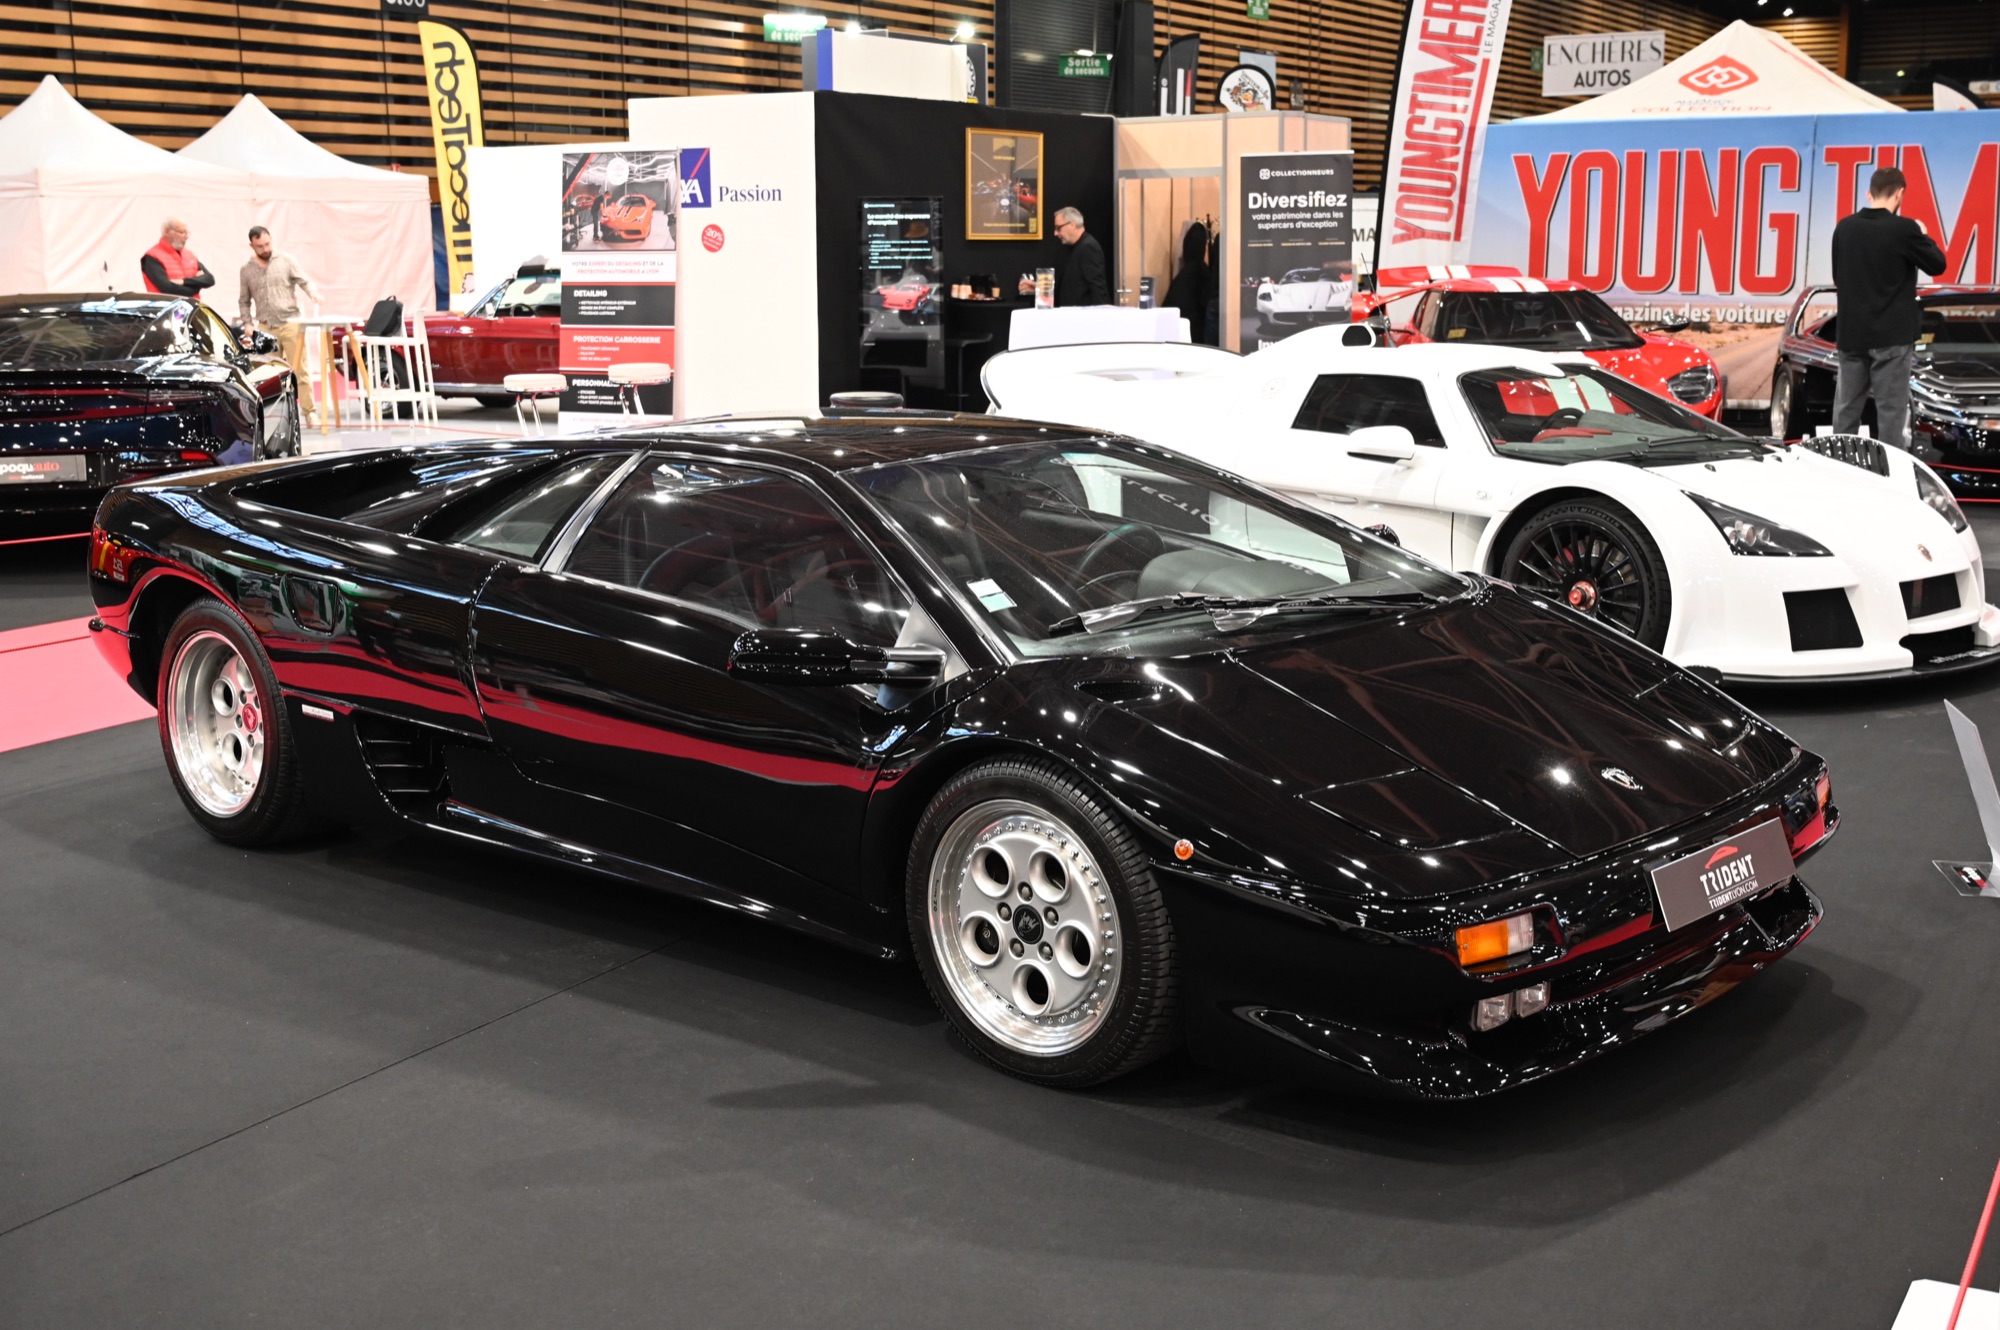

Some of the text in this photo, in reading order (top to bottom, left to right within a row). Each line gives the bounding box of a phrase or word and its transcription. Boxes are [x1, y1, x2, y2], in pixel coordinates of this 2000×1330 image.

[771, 30, 782, 40] de
[1483, 0, 1502, 53] LE MAGA
[1547, 35, 1661, 66] ENCHÈRES
[1064, 67, 1073, 75] de
[1068, 57, 1100, 67] Sortie
[1573, 69, 1631, 88] AUTOS
[1392, 0, 1488, 245] YOUNGTIMER
[1271, 169, 1334, 177] COLLECTIONNEURS
[719, 184, 782, 202] Passion
[1248, 190, 1347, 209] Diversifiez
[1252, 210, 1344, 221] votre patrimoine dans les
[1257, 220, 1338, 230] supercars d'exception
[1512, 143, 2000, 295] YOUNG TM
[1679, 302, 1710, 322] des
[573, 335, 661, 344] PROTECTION CARROSSERIE
[1580, 508, 1620, 527] MICHELIN
[1700, 854, 1755, 896] TRIDENT
[1709, 880, 1759, 909] TRIDENTLYON.COM
